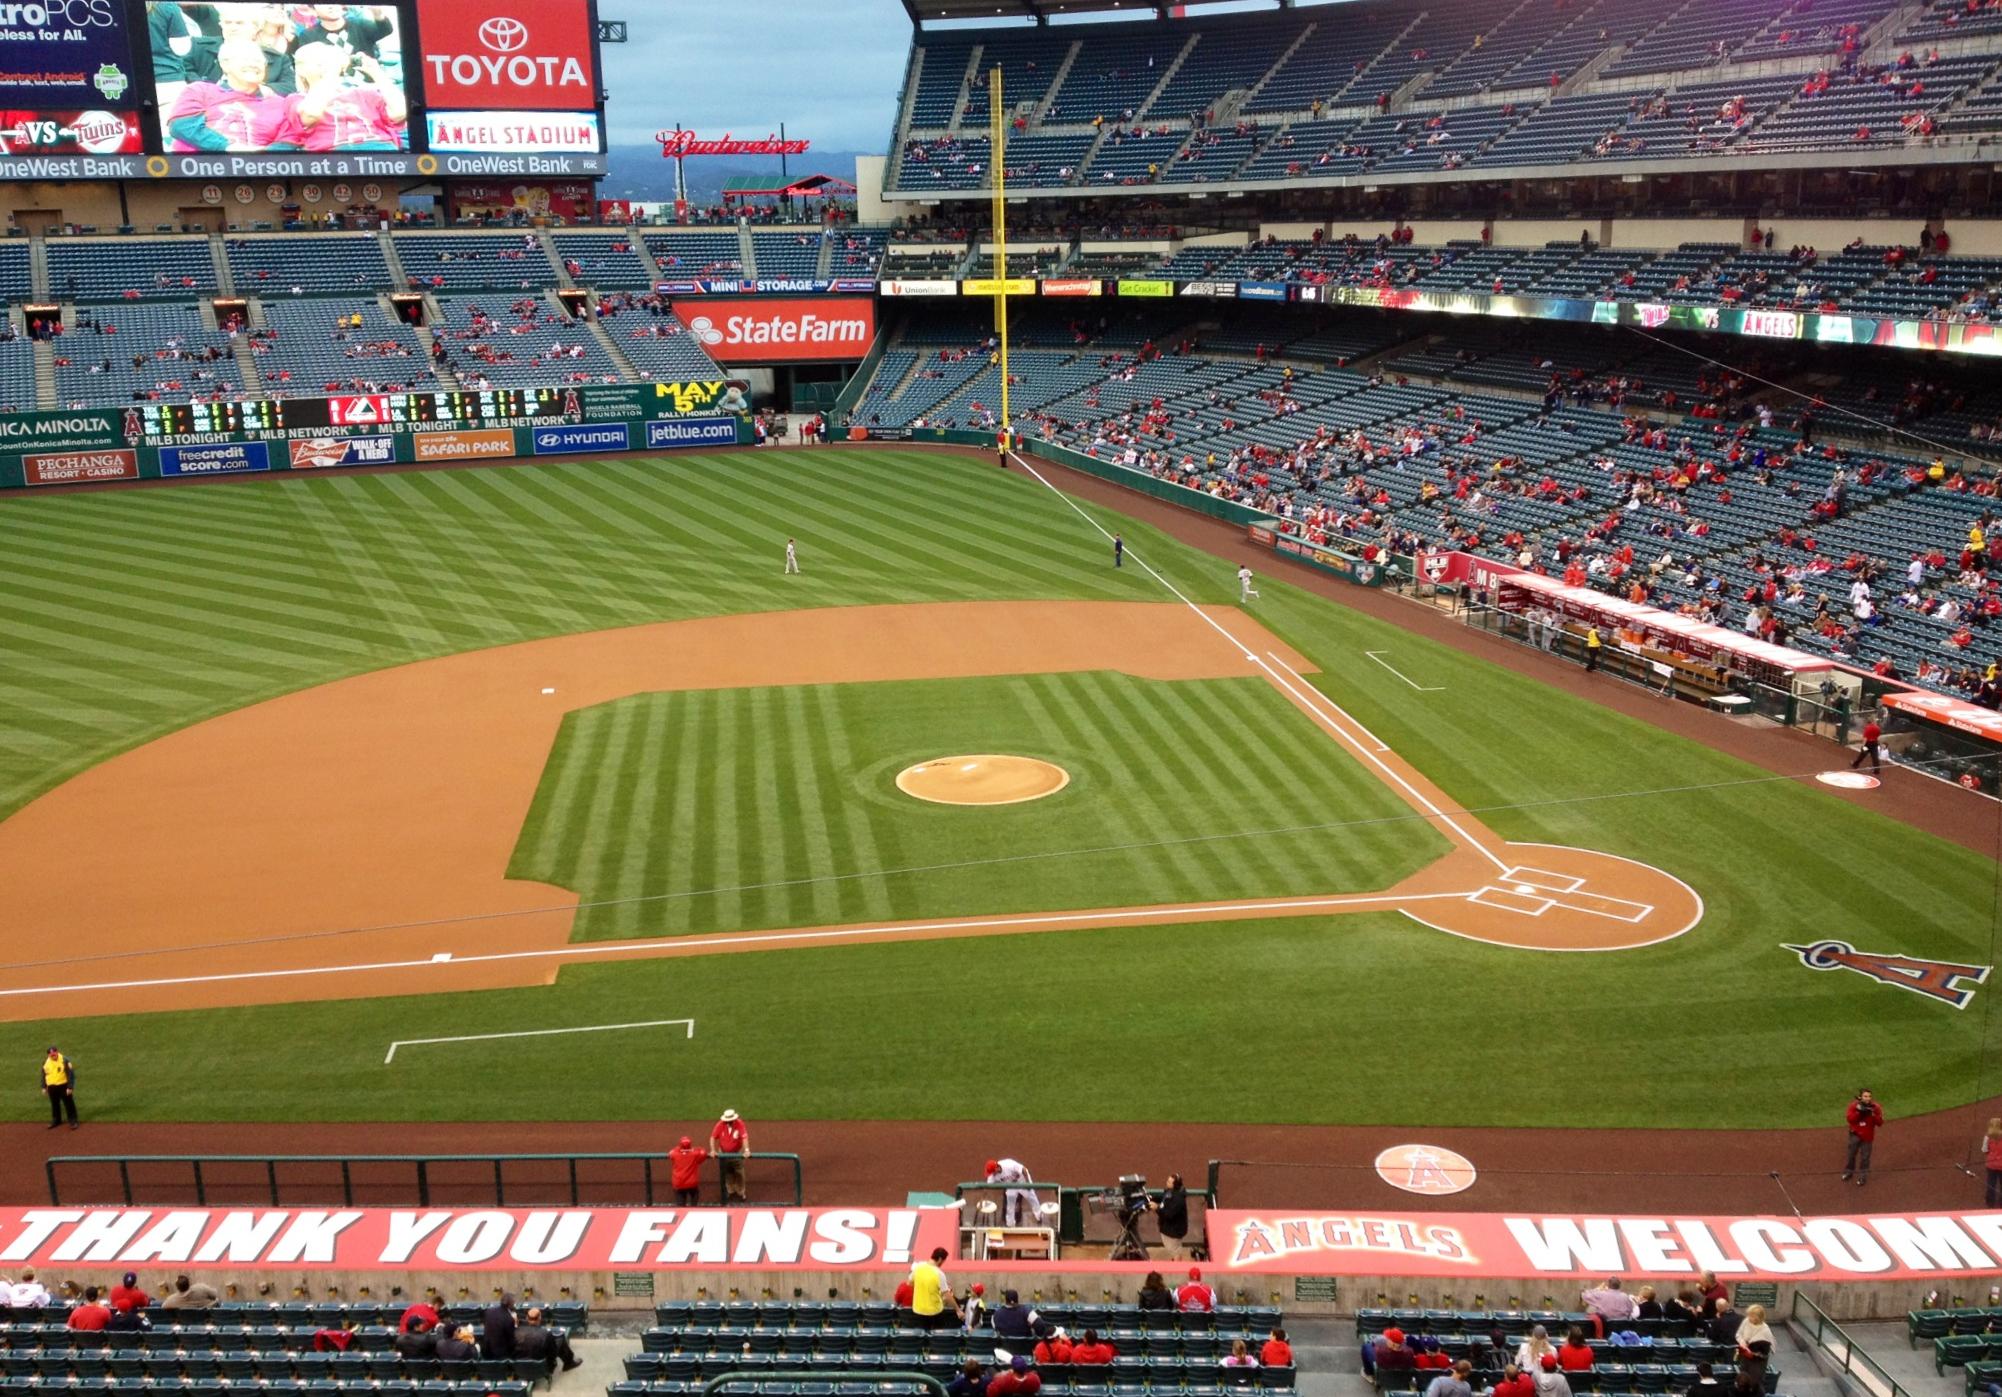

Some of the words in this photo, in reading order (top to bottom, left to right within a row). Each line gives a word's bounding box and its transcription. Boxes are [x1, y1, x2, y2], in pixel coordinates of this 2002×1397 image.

[39, 29, 59, 40] for
[64, 30, 86, 41] All.
[426, 54, 588, 86] TOYOTA
[25, 121, 56, 144] VS
[71, 120, 124, 144] Twins
[436, 121, 498, 145] ANGEL
[504, 125, 591, 144] STADIUM
[656, 130, 810, 158] Budweiser
[0, 158, 78, 176] neWest
[83, 157, 133, 177] Bank
[181, 157, 225, 175] One
[232, 157, 303, 175] Person
[310, 157, 331, 174] at
[337, 160, 349, 174] a
[354, 156, 407, 174] Time
[447, 156, 524, 173] OneWest
[530, 156, 571, 173] Bank
[710, 282, 738, 292] MINI
[1743, 313, 1795, 336] ANGELS
[656, 381, 724, 397] MAY
[586, 410, 642, 418] FOUNDATION
[0, 422, 32, 436] ICA
[35, 418, 111, 434] MINOLTA
[378, 422, 404, 434] MLB
[407, 420, 458, 432] TONIGHT
[485, 417, 509, 429] MLB
[510, 416, 565, 427] NETWORK
[146, 435, 174, 447] MLB
[175, 433, 230, 445] TONIGHT
[260, 429, 285, 440] MLB
[288, 426, 349, 439] NETWORK
[564, 431, 624, 444] HYUNDAI
[651, 424, 733, 443] jetblue.com
[178, 447, 244, 460] freecredit
[358, 451, 365, 460] A
[366, 449, 388, 460] HERO
[420, 443, 470, 456] SAFARI
[473, 441, 510, 453] PARK
[37, 455, 124, 470] PECHANGA
[180, 459, 248, 471] score.com
[40, 470, 79, 479] RESORT
[87, 468, 124, 477] CASINO
[0, 1210, 364, 1263] THANK
[378, 1210, 592, 1263] YOU
[607, 1209, 918, 1263] FANS!
[1233, 1219, 1470, 1264] ANGELS
